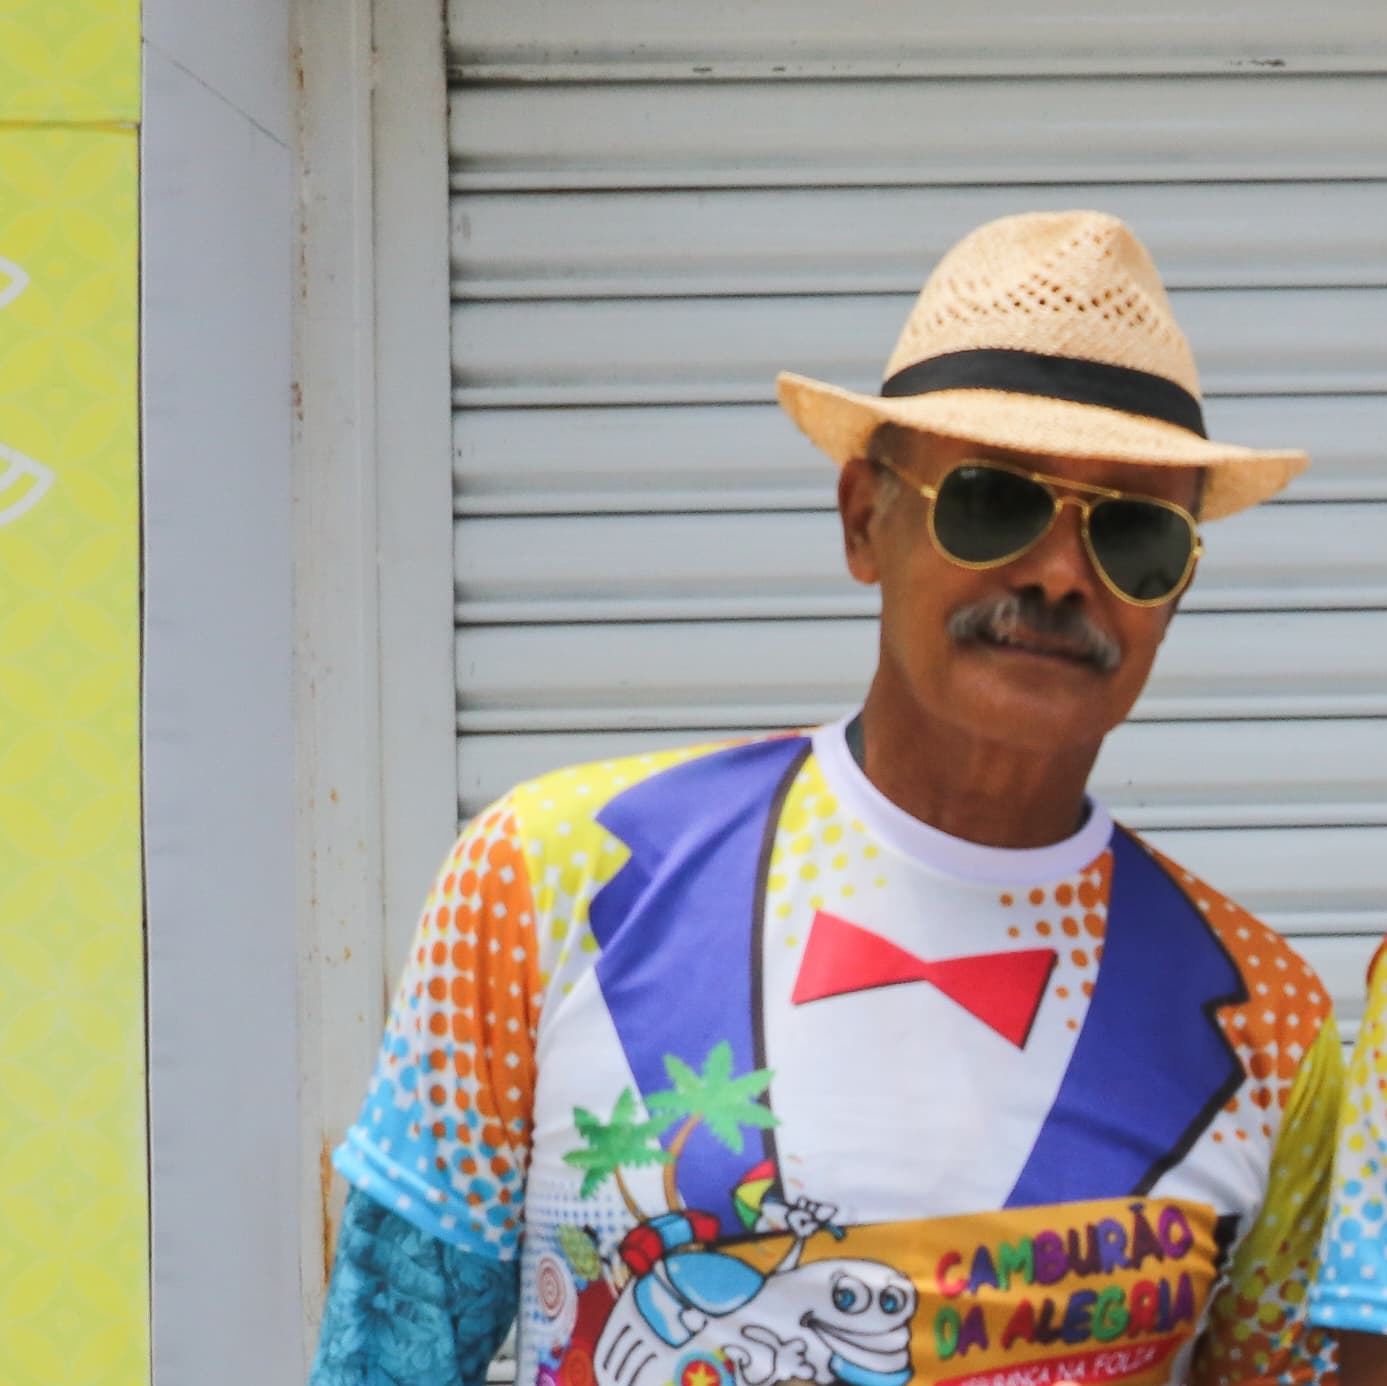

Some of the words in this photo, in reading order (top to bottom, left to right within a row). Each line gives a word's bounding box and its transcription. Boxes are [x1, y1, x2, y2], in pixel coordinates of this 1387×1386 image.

[935, 1202, 1194, 1298] CAMBURÃO
[933, 1305, 989, 1360] DA
[1001, 1271, 1195, 1352] ALEGRIA
